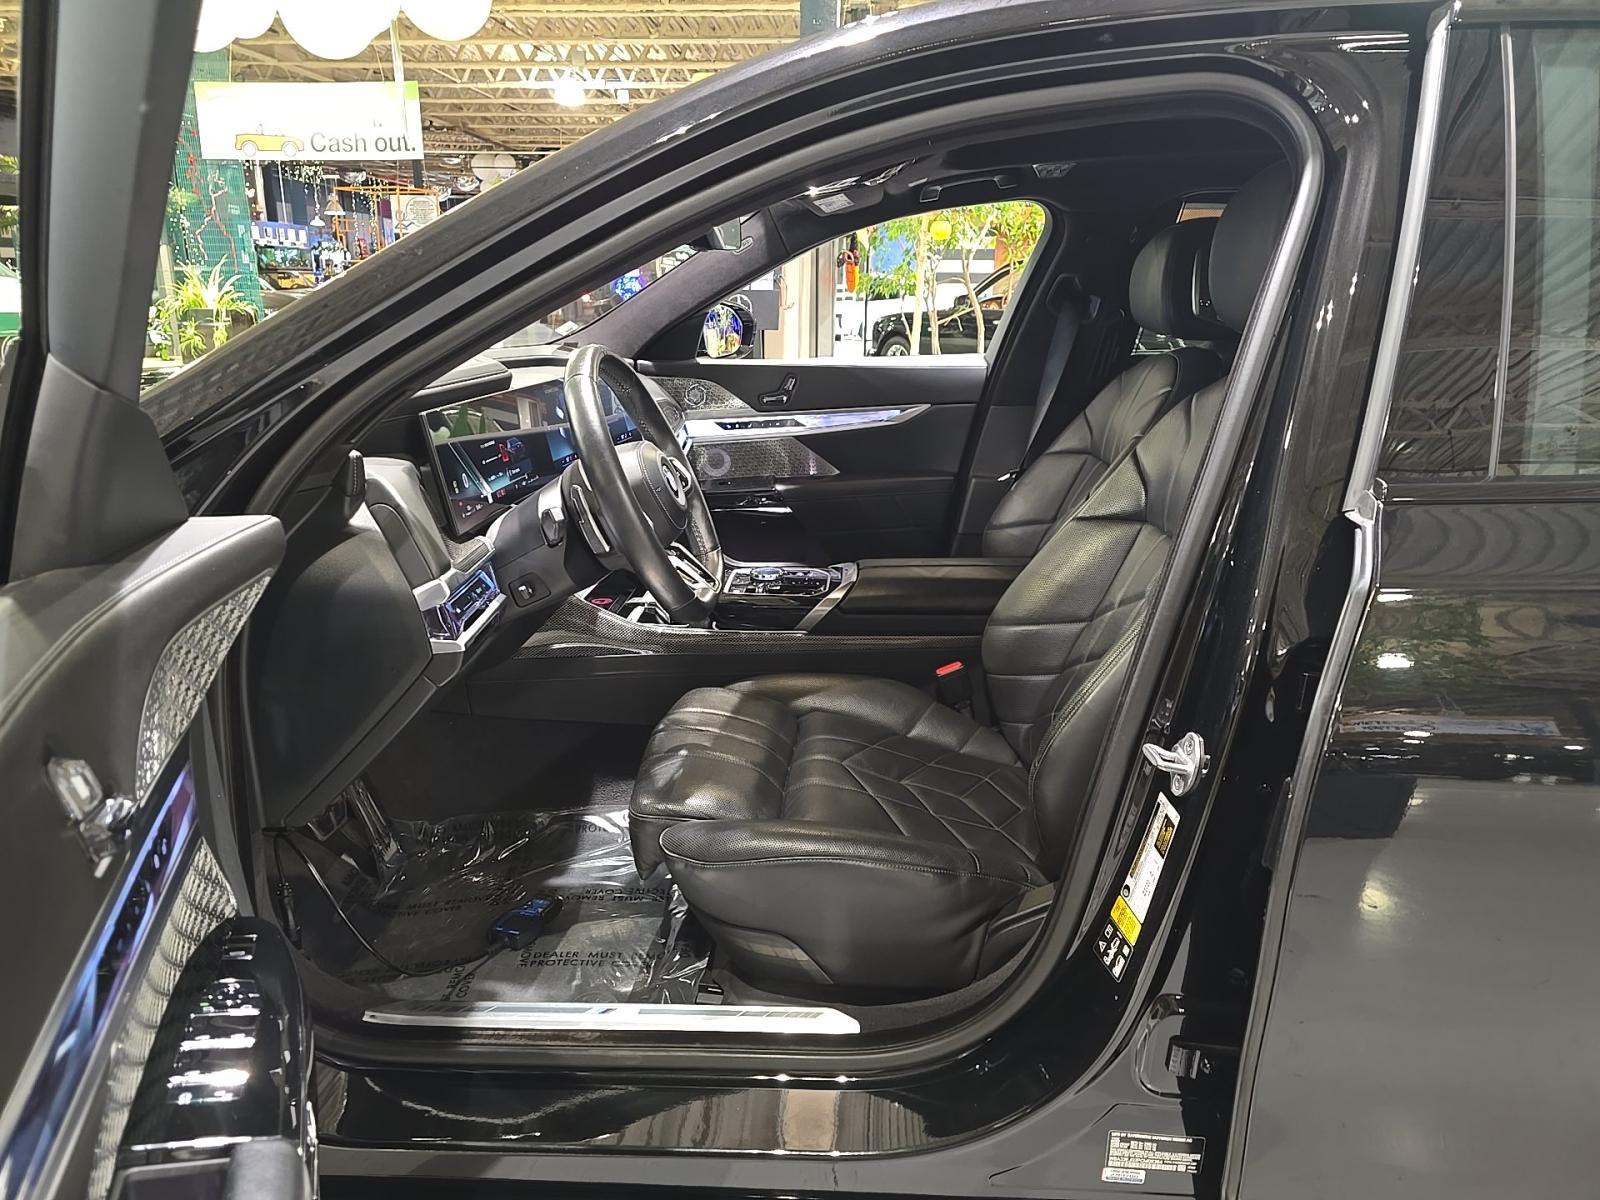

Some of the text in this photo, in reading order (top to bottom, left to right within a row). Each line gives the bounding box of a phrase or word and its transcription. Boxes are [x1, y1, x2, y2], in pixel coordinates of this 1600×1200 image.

[310, 131, 415, 152] Cash out.
[533, 951, 580, 959] DEALER
[588, 951, 622, 959] MUST
[529, 959, 605, 968] PROTECTIVE
